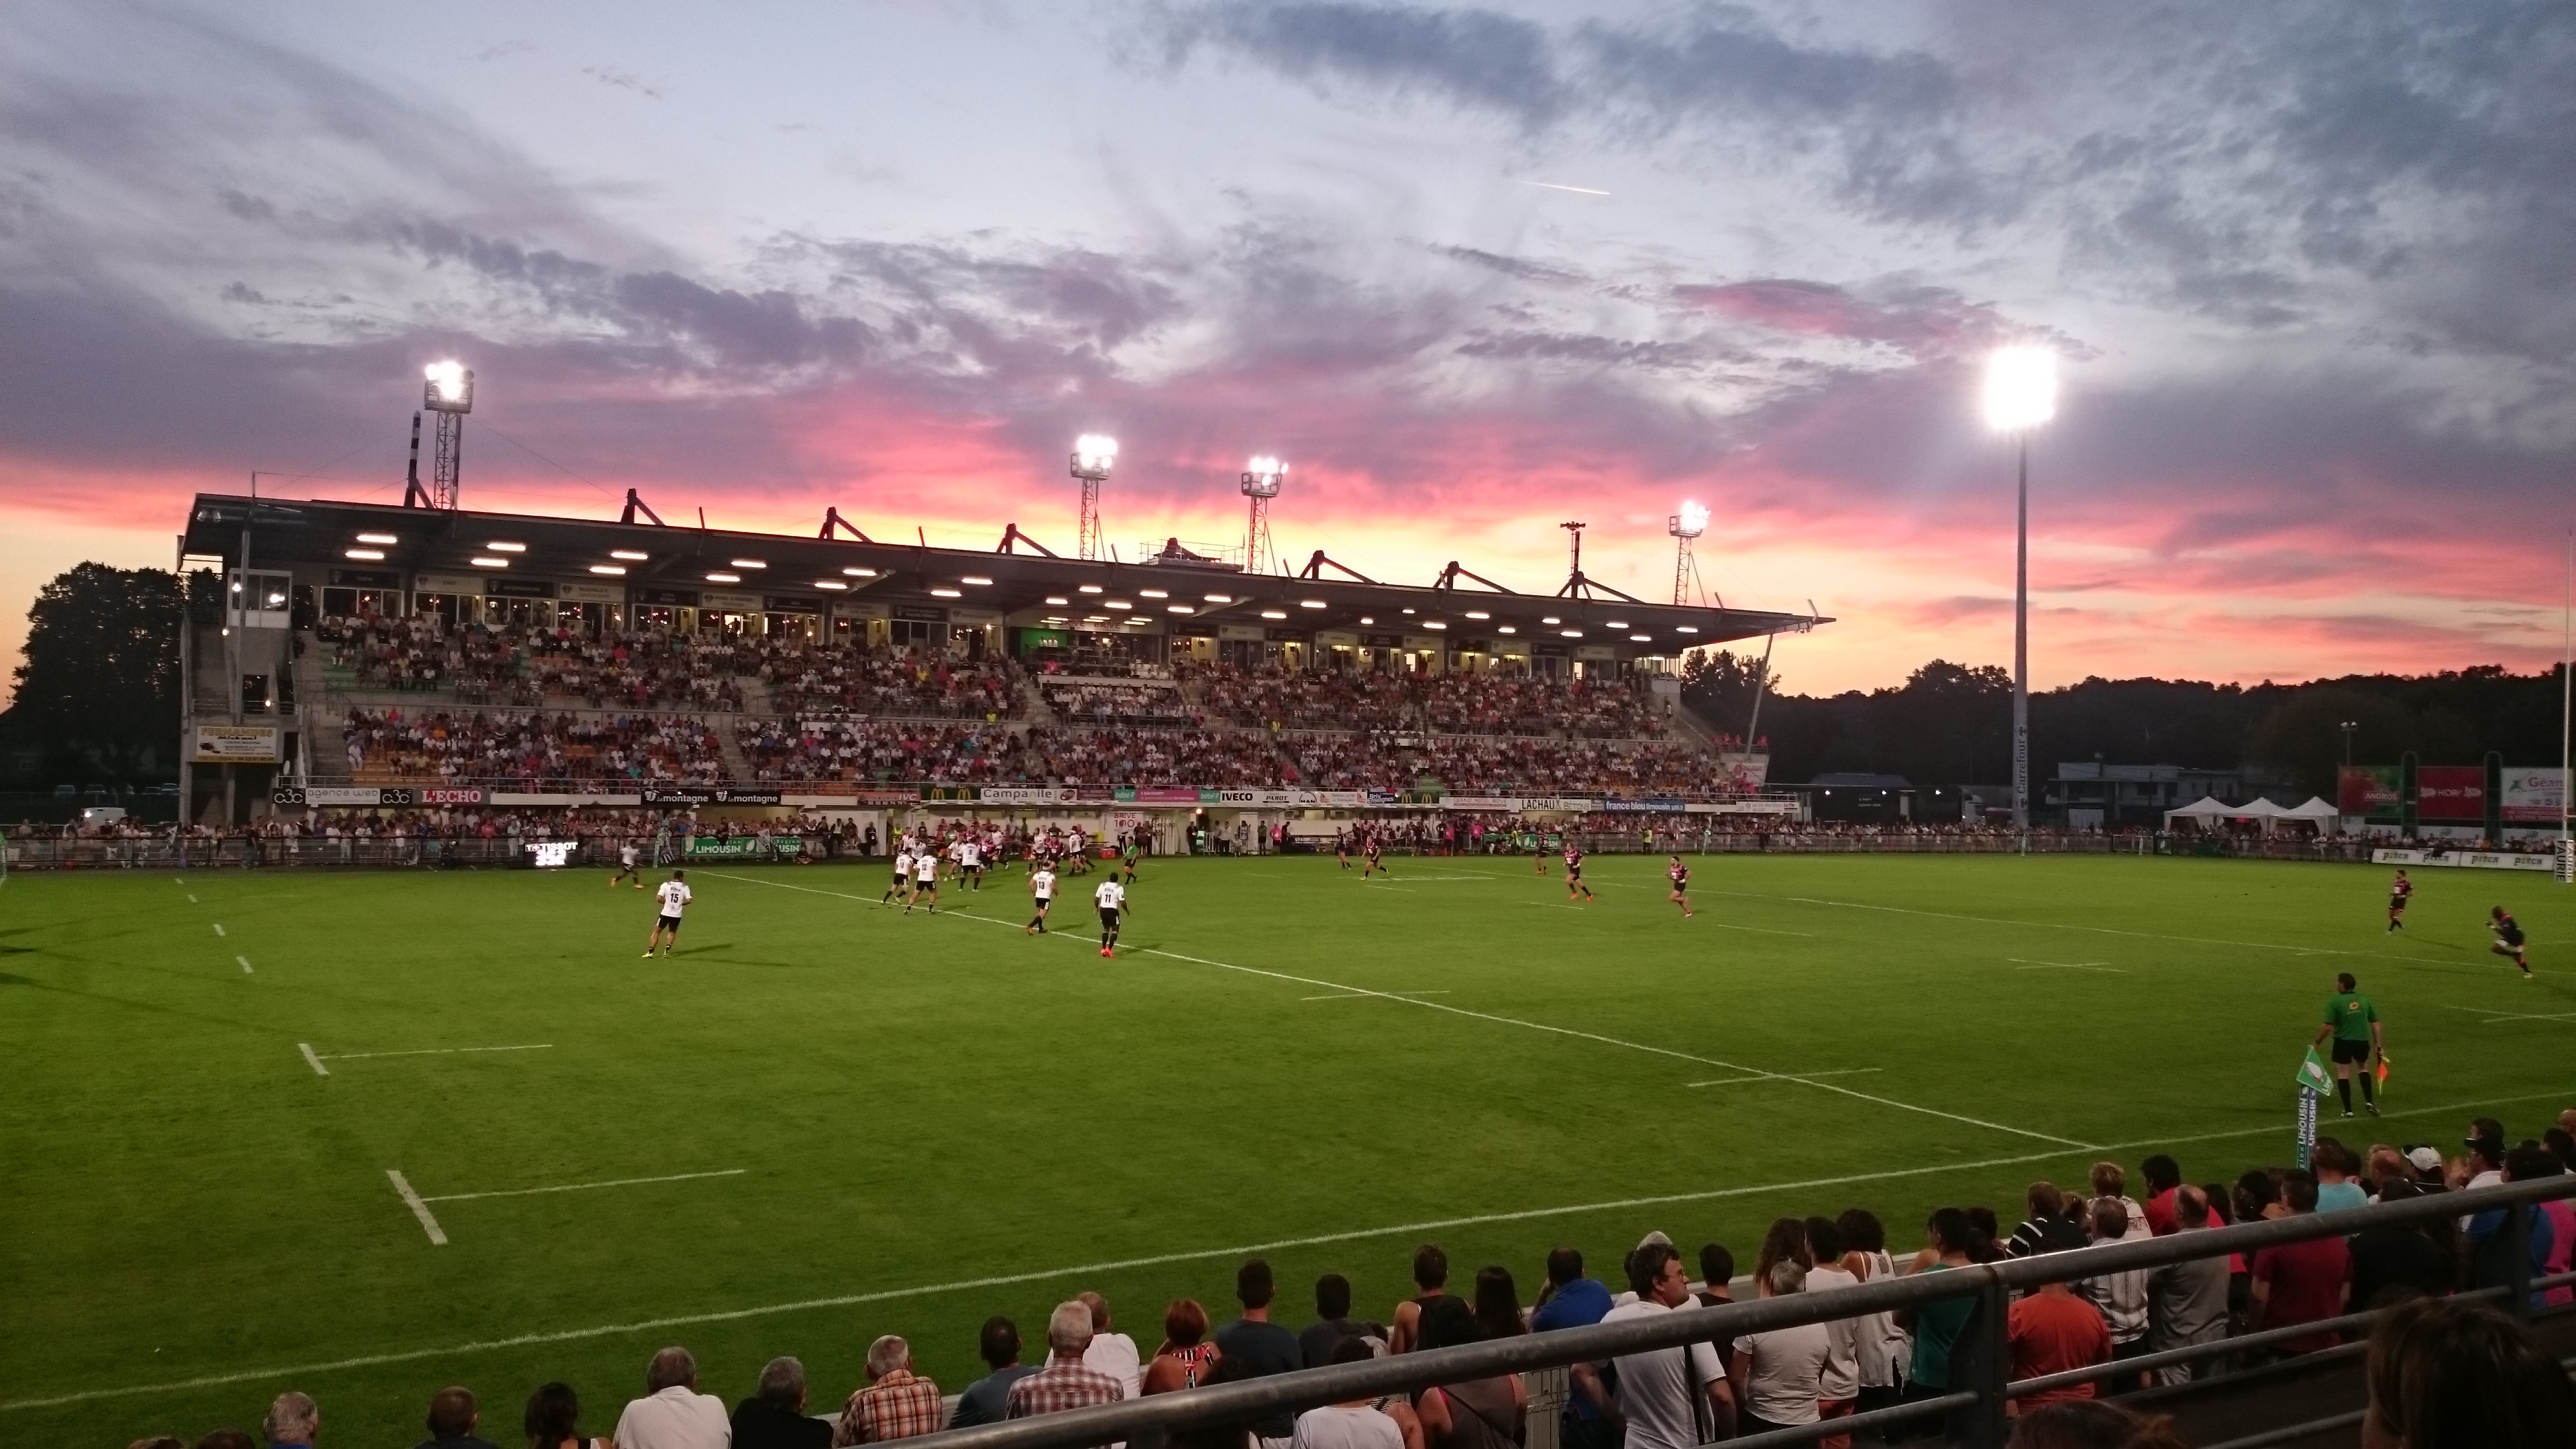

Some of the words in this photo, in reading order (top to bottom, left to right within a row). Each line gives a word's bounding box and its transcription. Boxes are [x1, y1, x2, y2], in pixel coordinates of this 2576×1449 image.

[2017, 739, 2026, 794] Carrefour
[2528, 775, 2566, 788] Géan
[307, 790, 350, 798] agence
[421, 790, 482, 803] L'ECHO
[983, 788, 1053, 800] Campanile
[1221, 792, 1253, 801] IVECO
[2365, 792, 2398, 801] ANDROS
[1521, 798, 1562, 810] LACHAUX
[1605, 801, 1630, 810] france
[1630, 800, 1646, 810] bleu
[1646, 802, 1670, 810] limousin
[540, 842, 578, 851] TISSOT
[696, 845, 741, 853] LIMOUSIN
[2382, 851, 2409, 861] pitch
[2471, 855, 2499, 865] pitch
[2557, 841, 2567, 881] FAURIE
[2513, 857, 2543, 866] pitch
[1038, 881, 1045, 890] 13
[670, 892, 680, 903] 15
[1105, 894, 1112, 904] 11
[2298, 1097, 2308, 1145] LIMOUSIN
